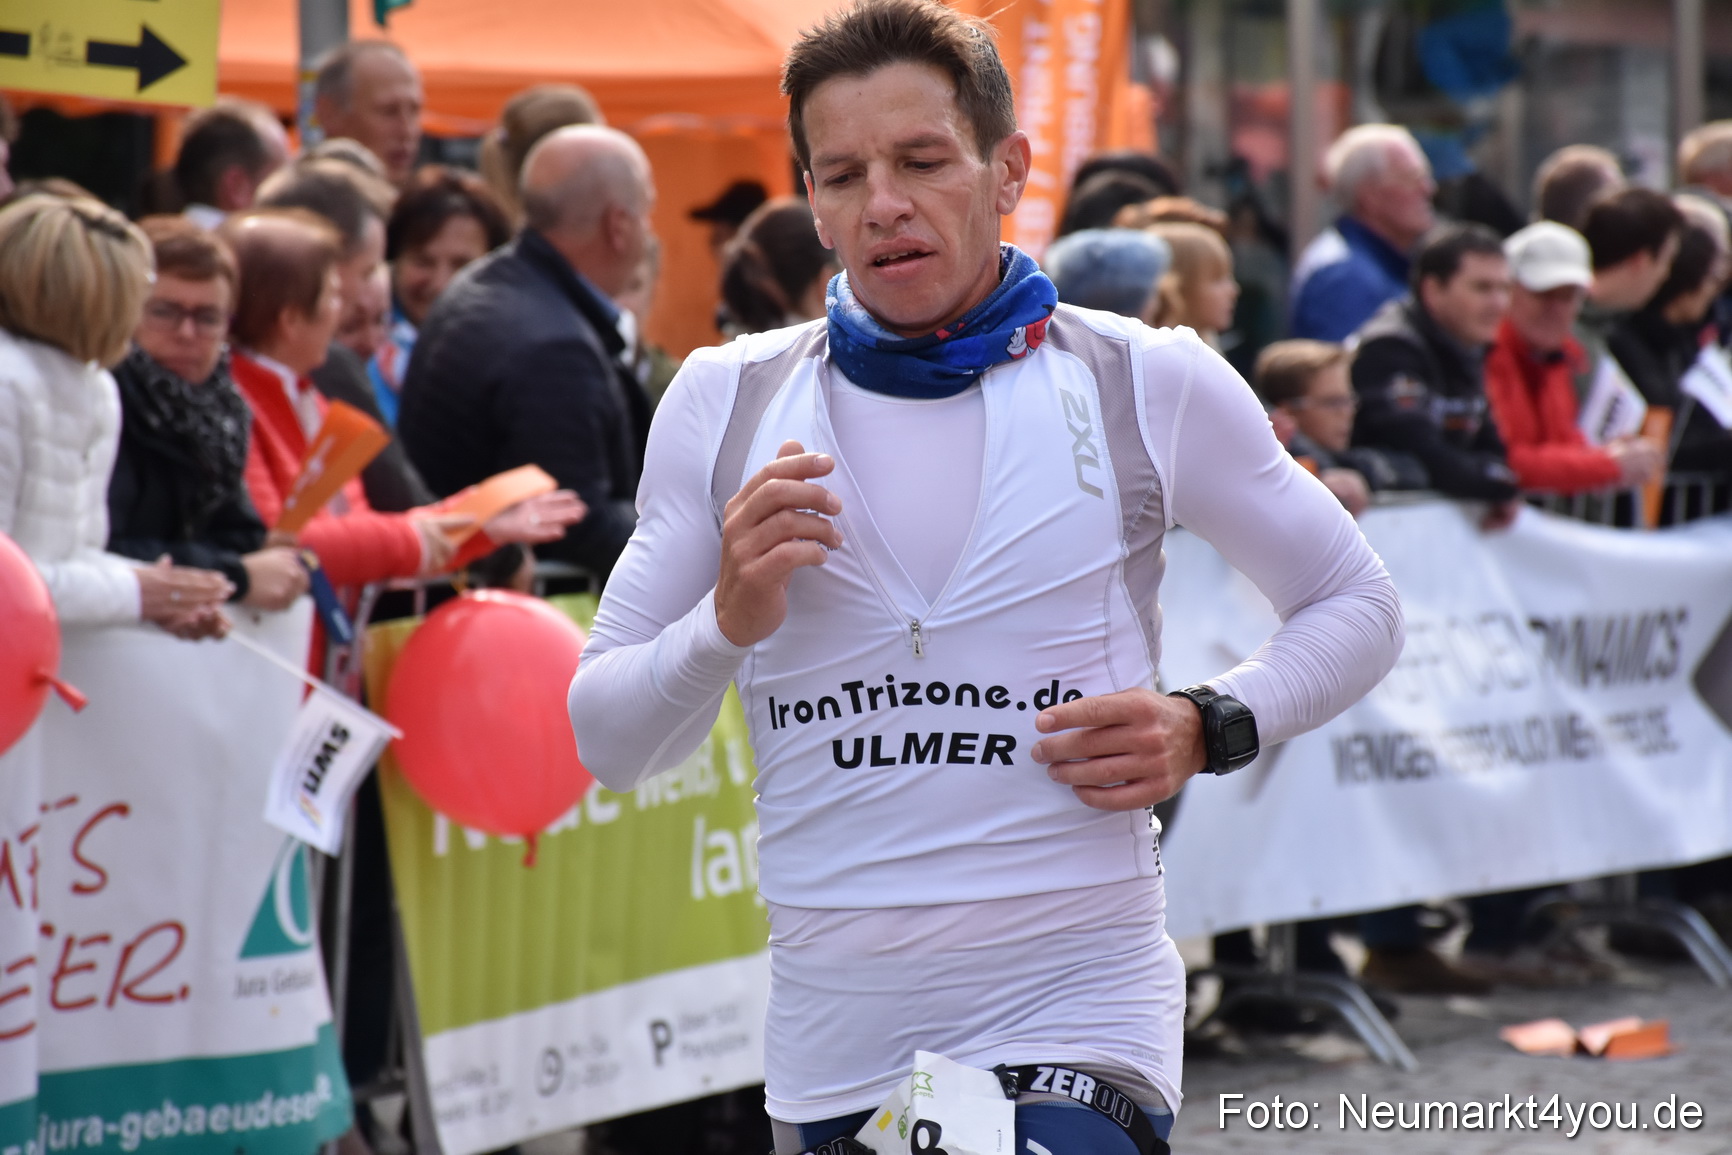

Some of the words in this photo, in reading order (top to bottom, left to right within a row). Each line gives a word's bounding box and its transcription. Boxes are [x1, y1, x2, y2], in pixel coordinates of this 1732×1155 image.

[1059, 387, 1104, 500] 2XU
[832, 731, 1018, 769] ULMER
[1030, 1066, 1134, 1128] ZEROD
